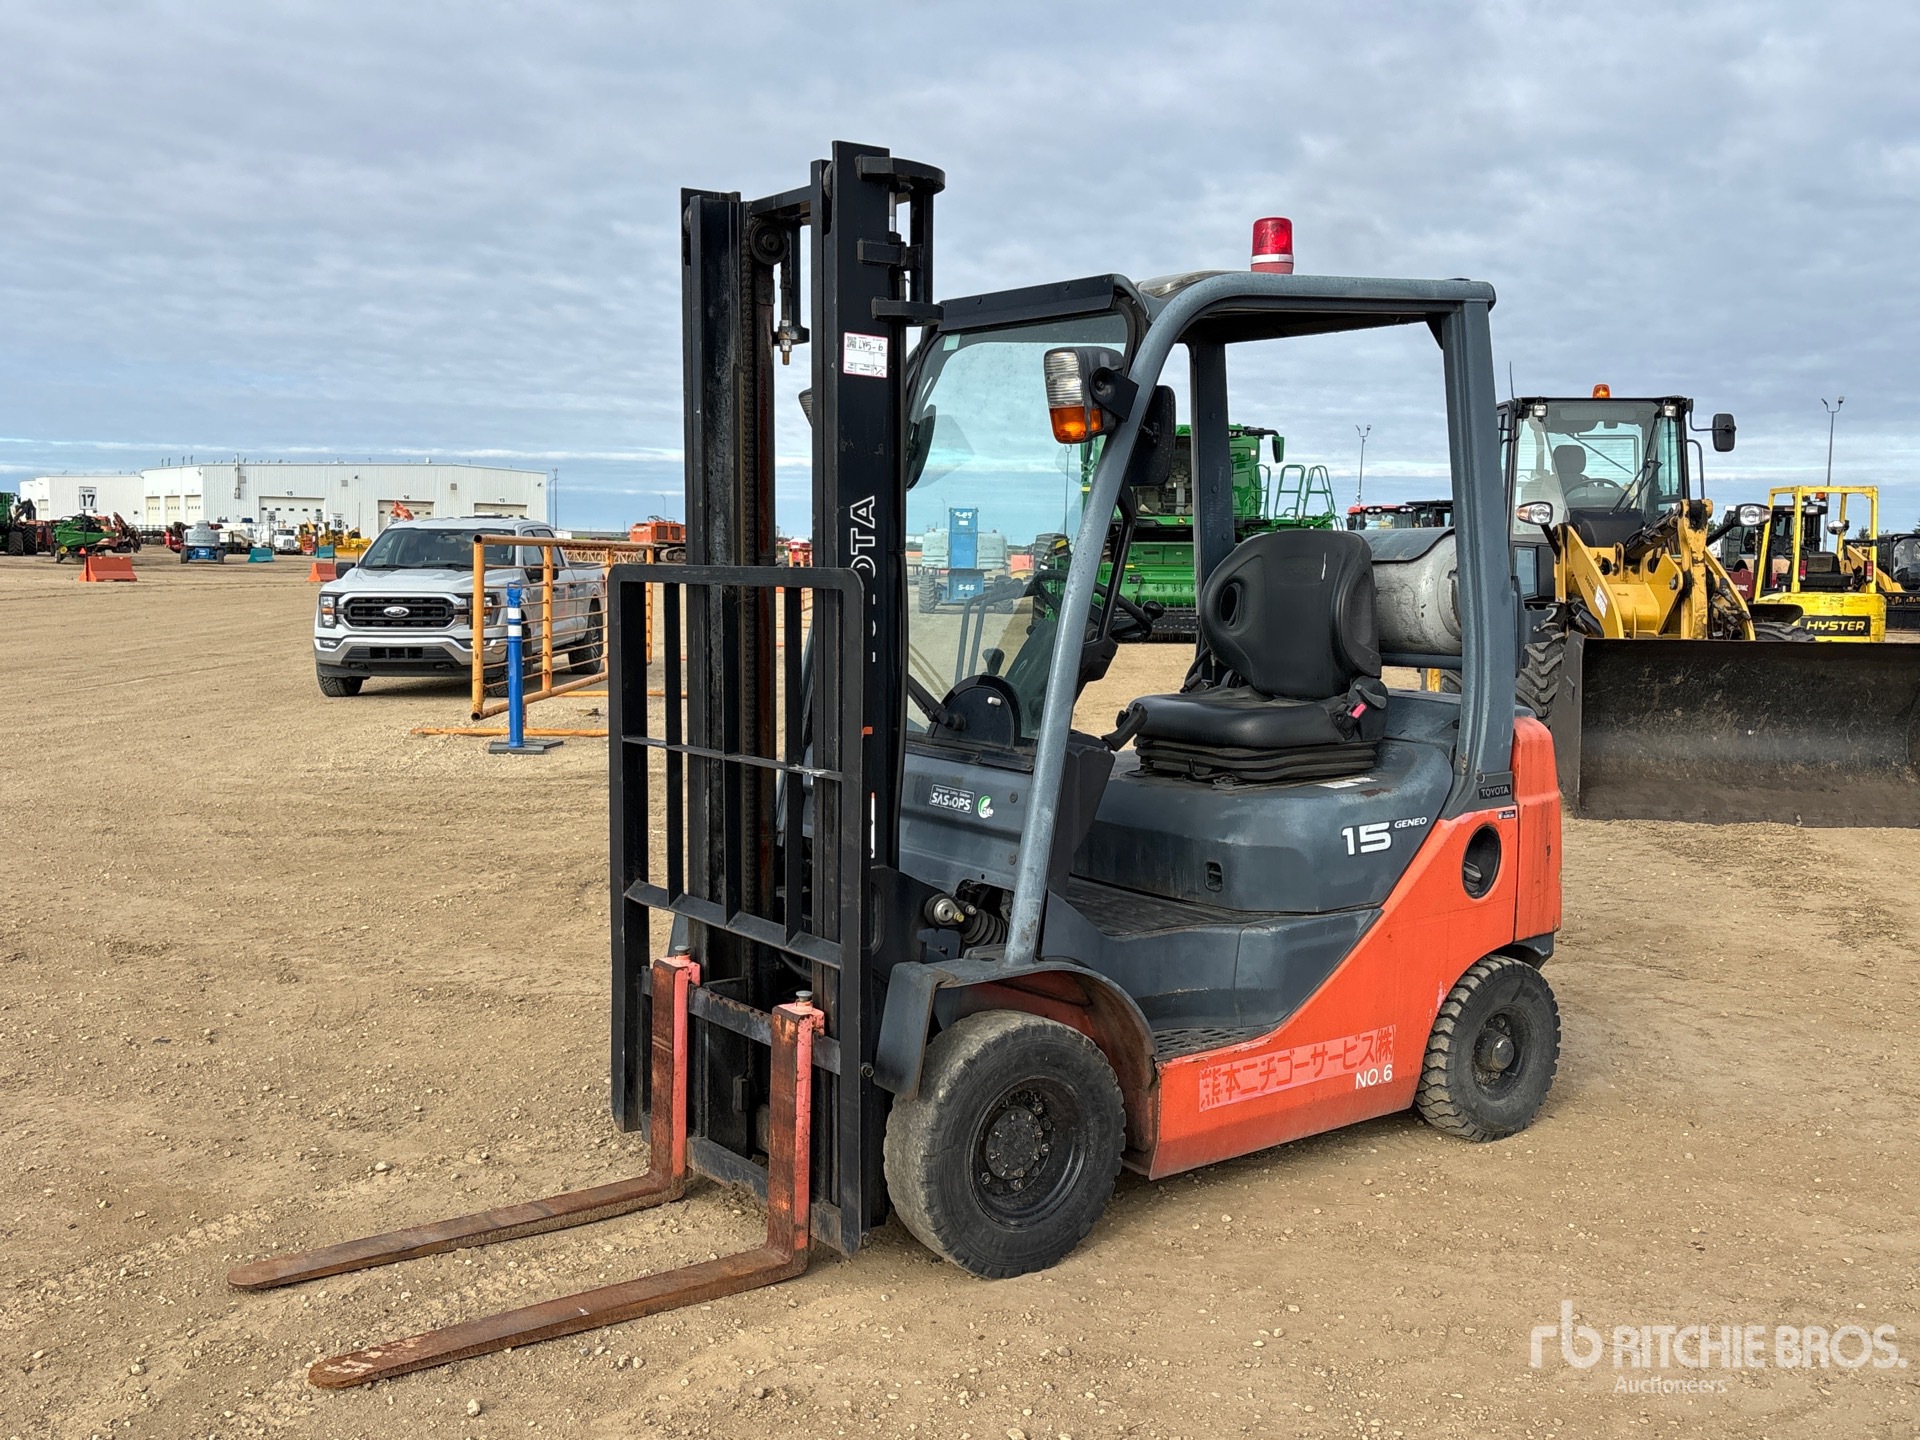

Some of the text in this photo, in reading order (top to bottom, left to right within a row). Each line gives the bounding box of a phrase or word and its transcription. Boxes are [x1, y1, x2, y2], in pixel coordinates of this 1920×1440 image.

[81, 494, 95, 507] 17
[333, 519, 343, 529] 18
[1806, 620, 1865, 631] HYSTER
[1481, 785, 1509, 798] TOYOTA
[1341, 816, 1428, 856] 15 GENEO
[1355, 1063, 1393, 1090] NO.6
